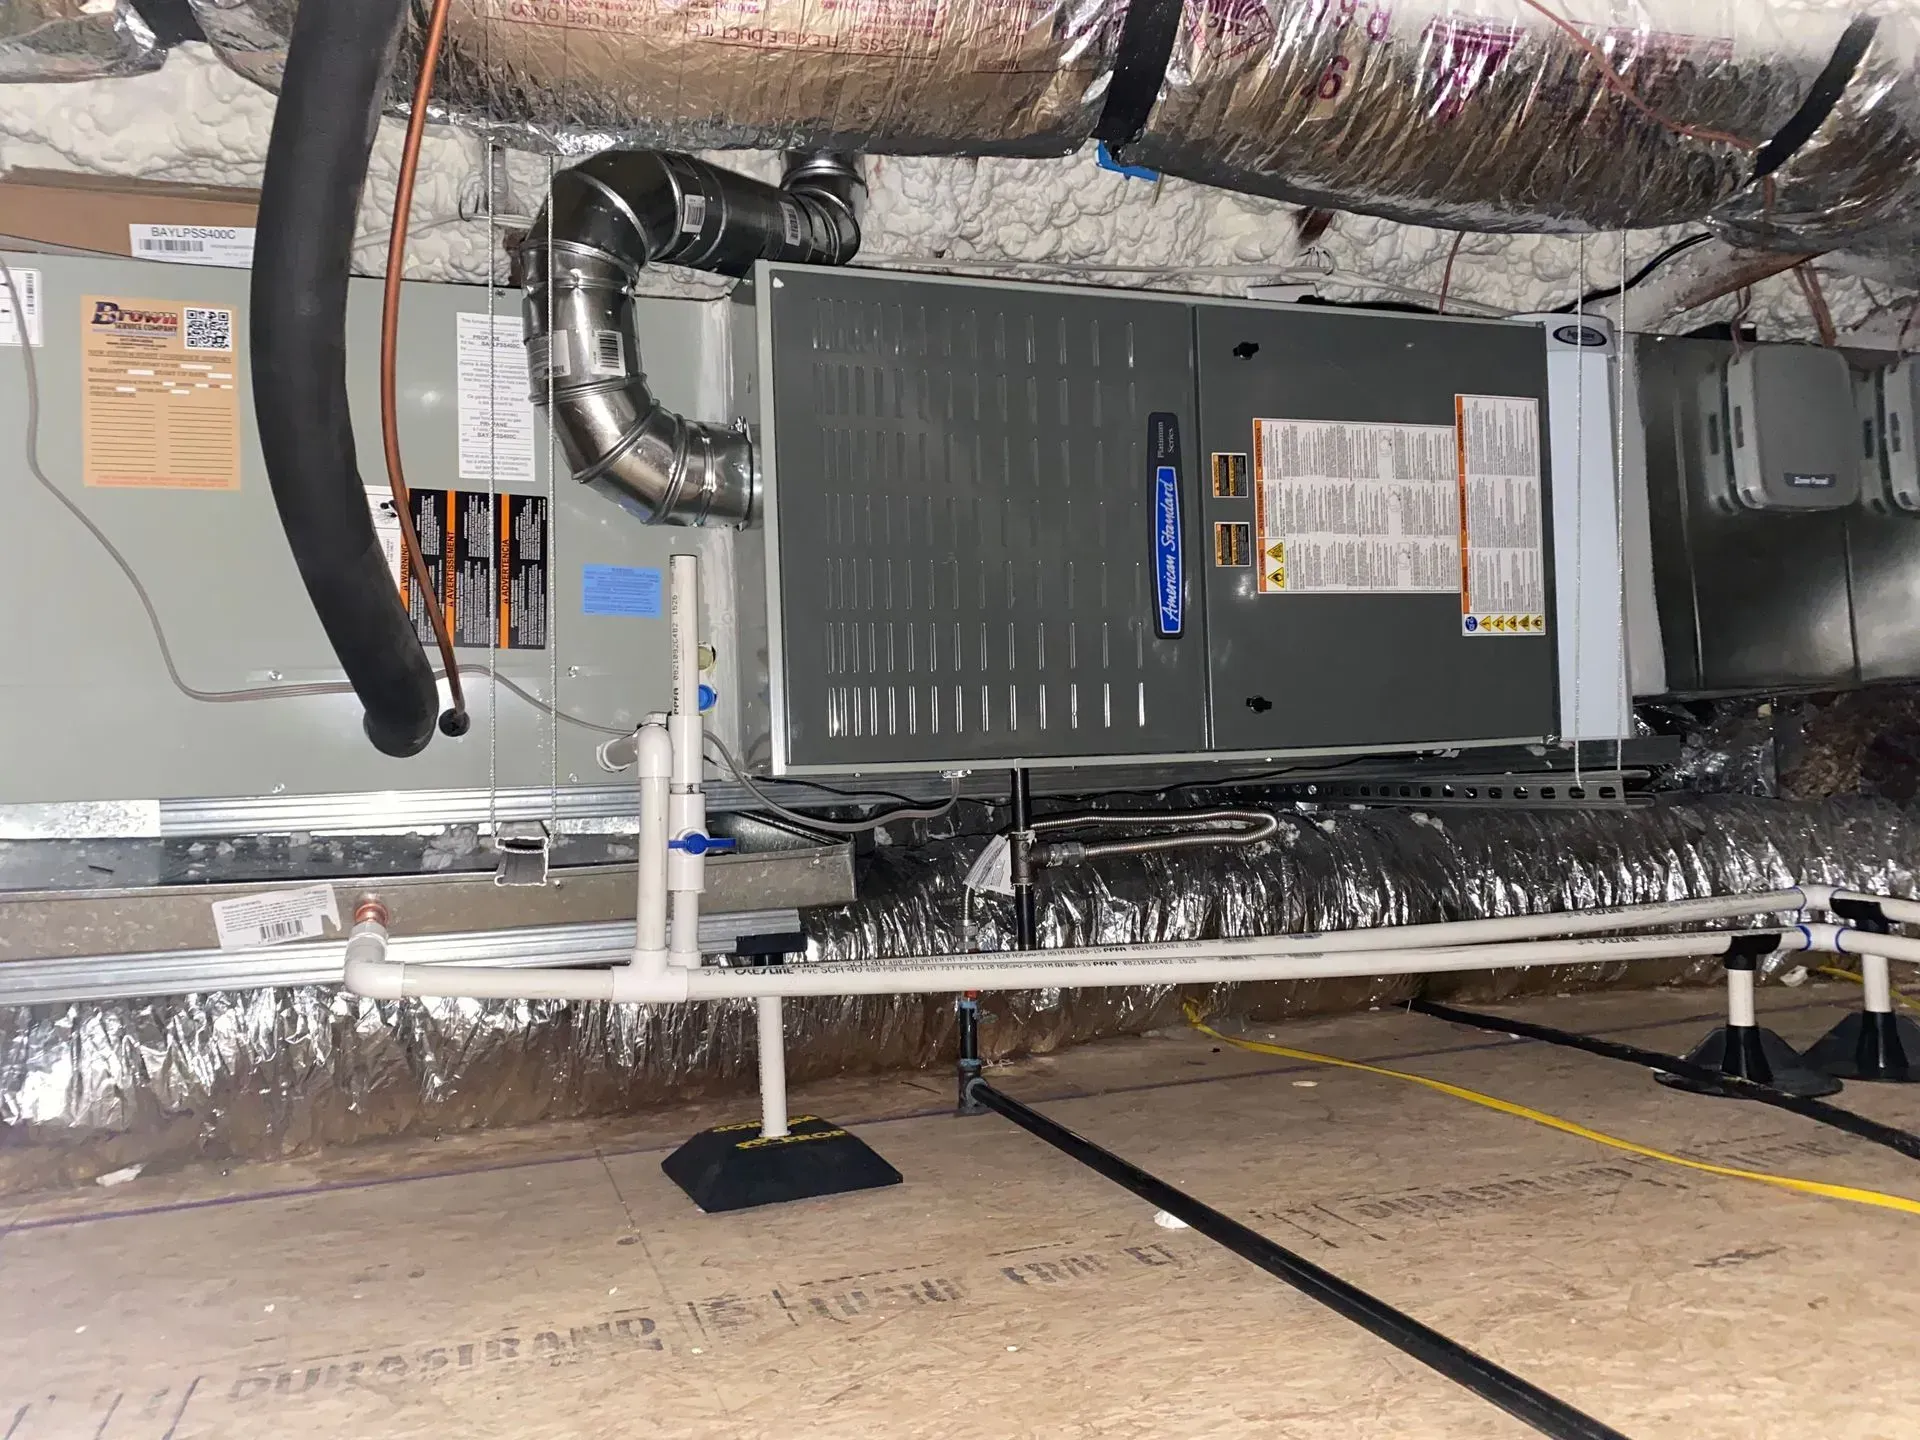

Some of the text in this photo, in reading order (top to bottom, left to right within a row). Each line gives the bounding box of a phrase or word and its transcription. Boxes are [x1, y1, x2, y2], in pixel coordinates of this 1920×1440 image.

[151, 227, 236, 240] BAYLPSS400C
[91, 301, 178, 325] Brown
[472, 334, 500, 342] PROPNE
[480, 341, 520, 350] BALPSS400C
[477, 432, 517, 440] BAYPSS400C
[1156, 422, 1165, 459] Platinum
[1166, 429, 1175, 454] Series
[1159, 479, 1178, 622] American Standard
[400, 543, 409, 584] WARNING
[446, 531, 455, 600] AVERTISSEMENT
[501, 539, 509, 596] ADVERTENCIA
[821, 966, 845, 976] SCH
[848, 965, 863, 974] 40
[959, 963, 975, 971] PVC
